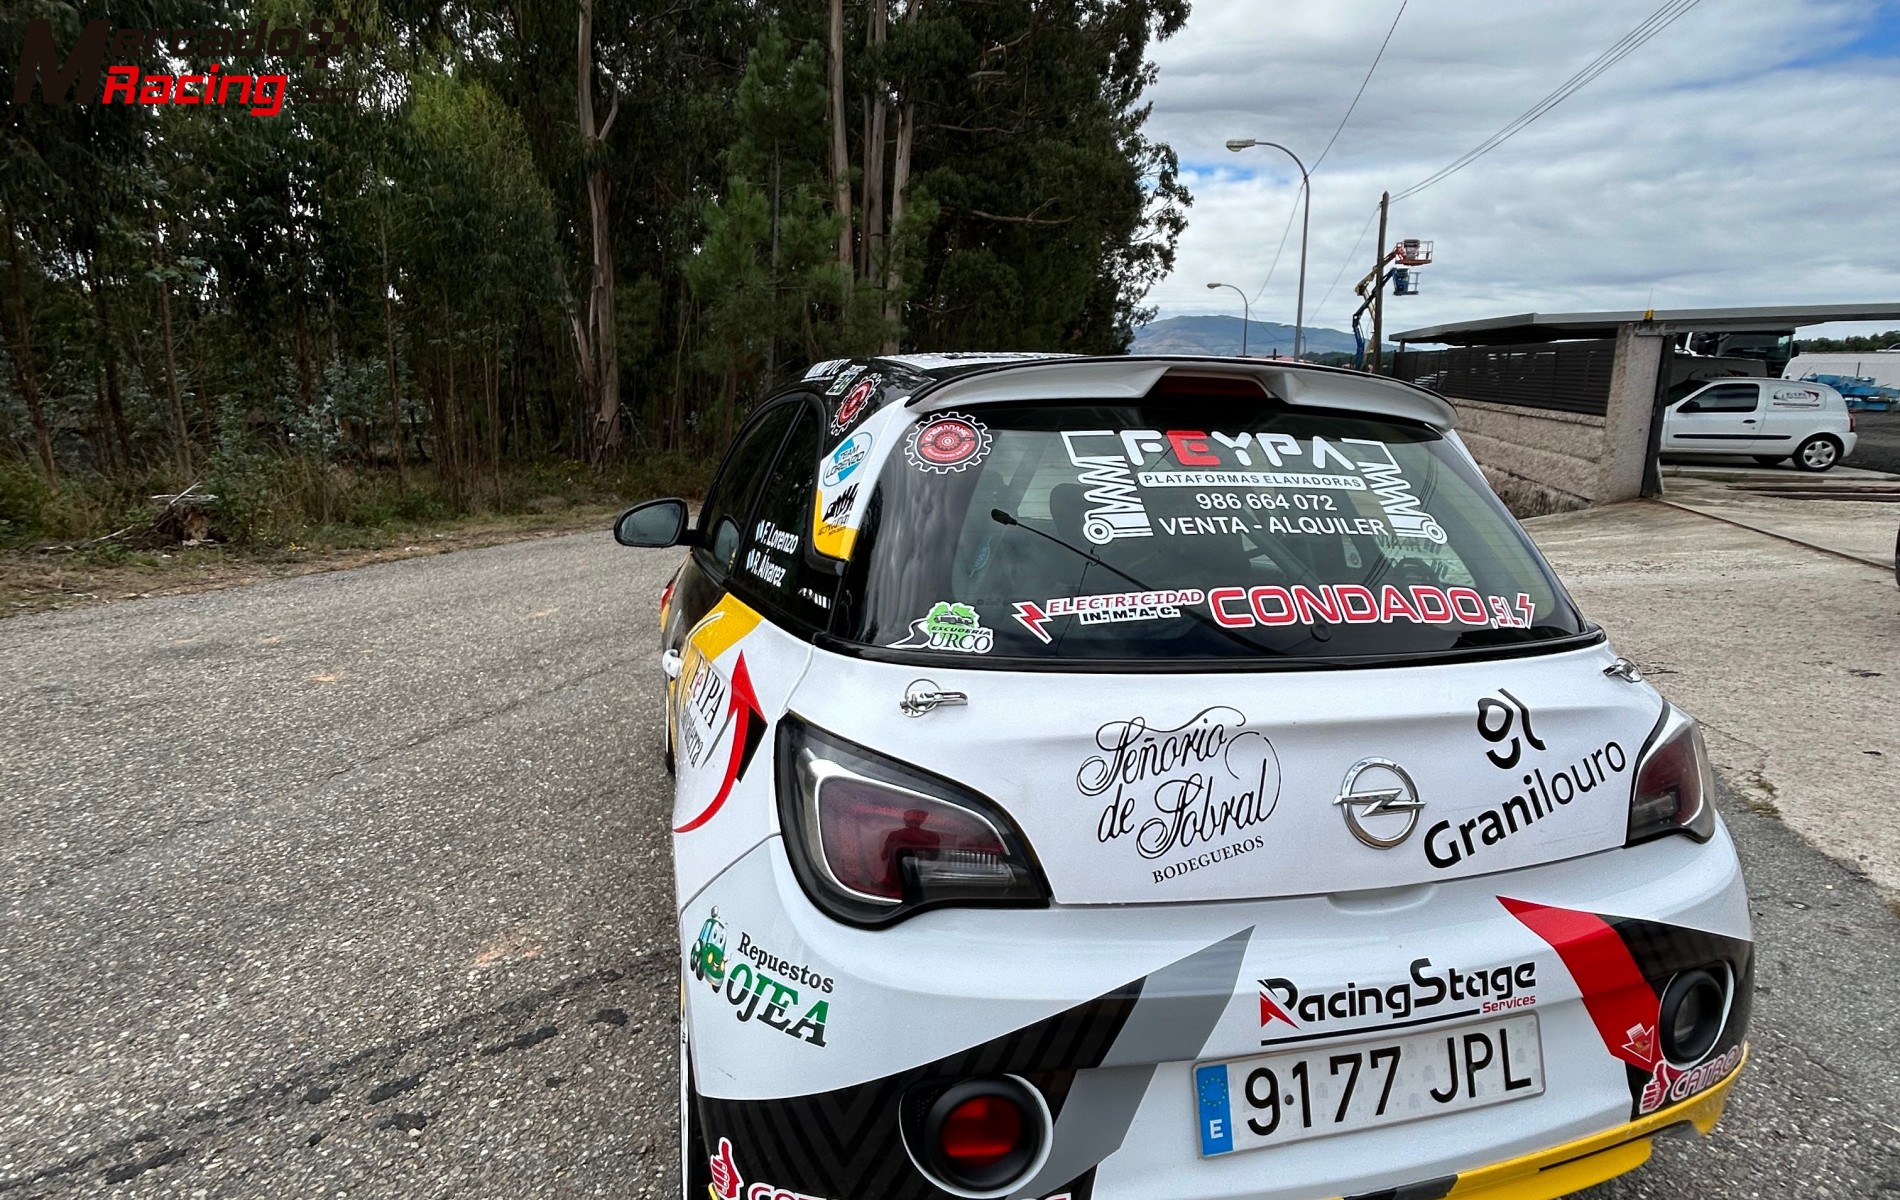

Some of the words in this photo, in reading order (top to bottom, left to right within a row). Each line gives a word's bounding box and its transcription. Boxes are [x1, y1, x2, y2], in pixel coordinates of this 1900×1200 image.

[1143, 473, 1260, 485] PLATAFORMAS
[1264, 474, 1362, 488] ELAVADORAS
[1196, 492, 1241, 511] 986
[1246, 493, 1290, 511] 664
[1293, 494, 1337, 512] 072
[1158, 516, 1249, 536] VENTA
[1268, 516, 1389, 537] ALQUILER
[1049, 591, 1203, 614] ELECTRICIDAD
[929, 632, 991, 651] URCO
[1098, 783, 1135, 843] de
[1136, 732, 1281, 859] Sobral
[1424, 741, 1626, 869] Granilouro
[1152, 836, 1264, 884] BODEGUEROS
[737, 932, 835, 994] Repuestos
[726, 963, 830, 1048] OJEA
[1482, 995, 1536, 1013] Services
[1245, 1046, 1401, 1136] 9177
[1430, 1028, 1532, 1104] JPL
[1670, 1038, 1746, 1102] CATRO
[1209, 1118, 1224, 1140] E
